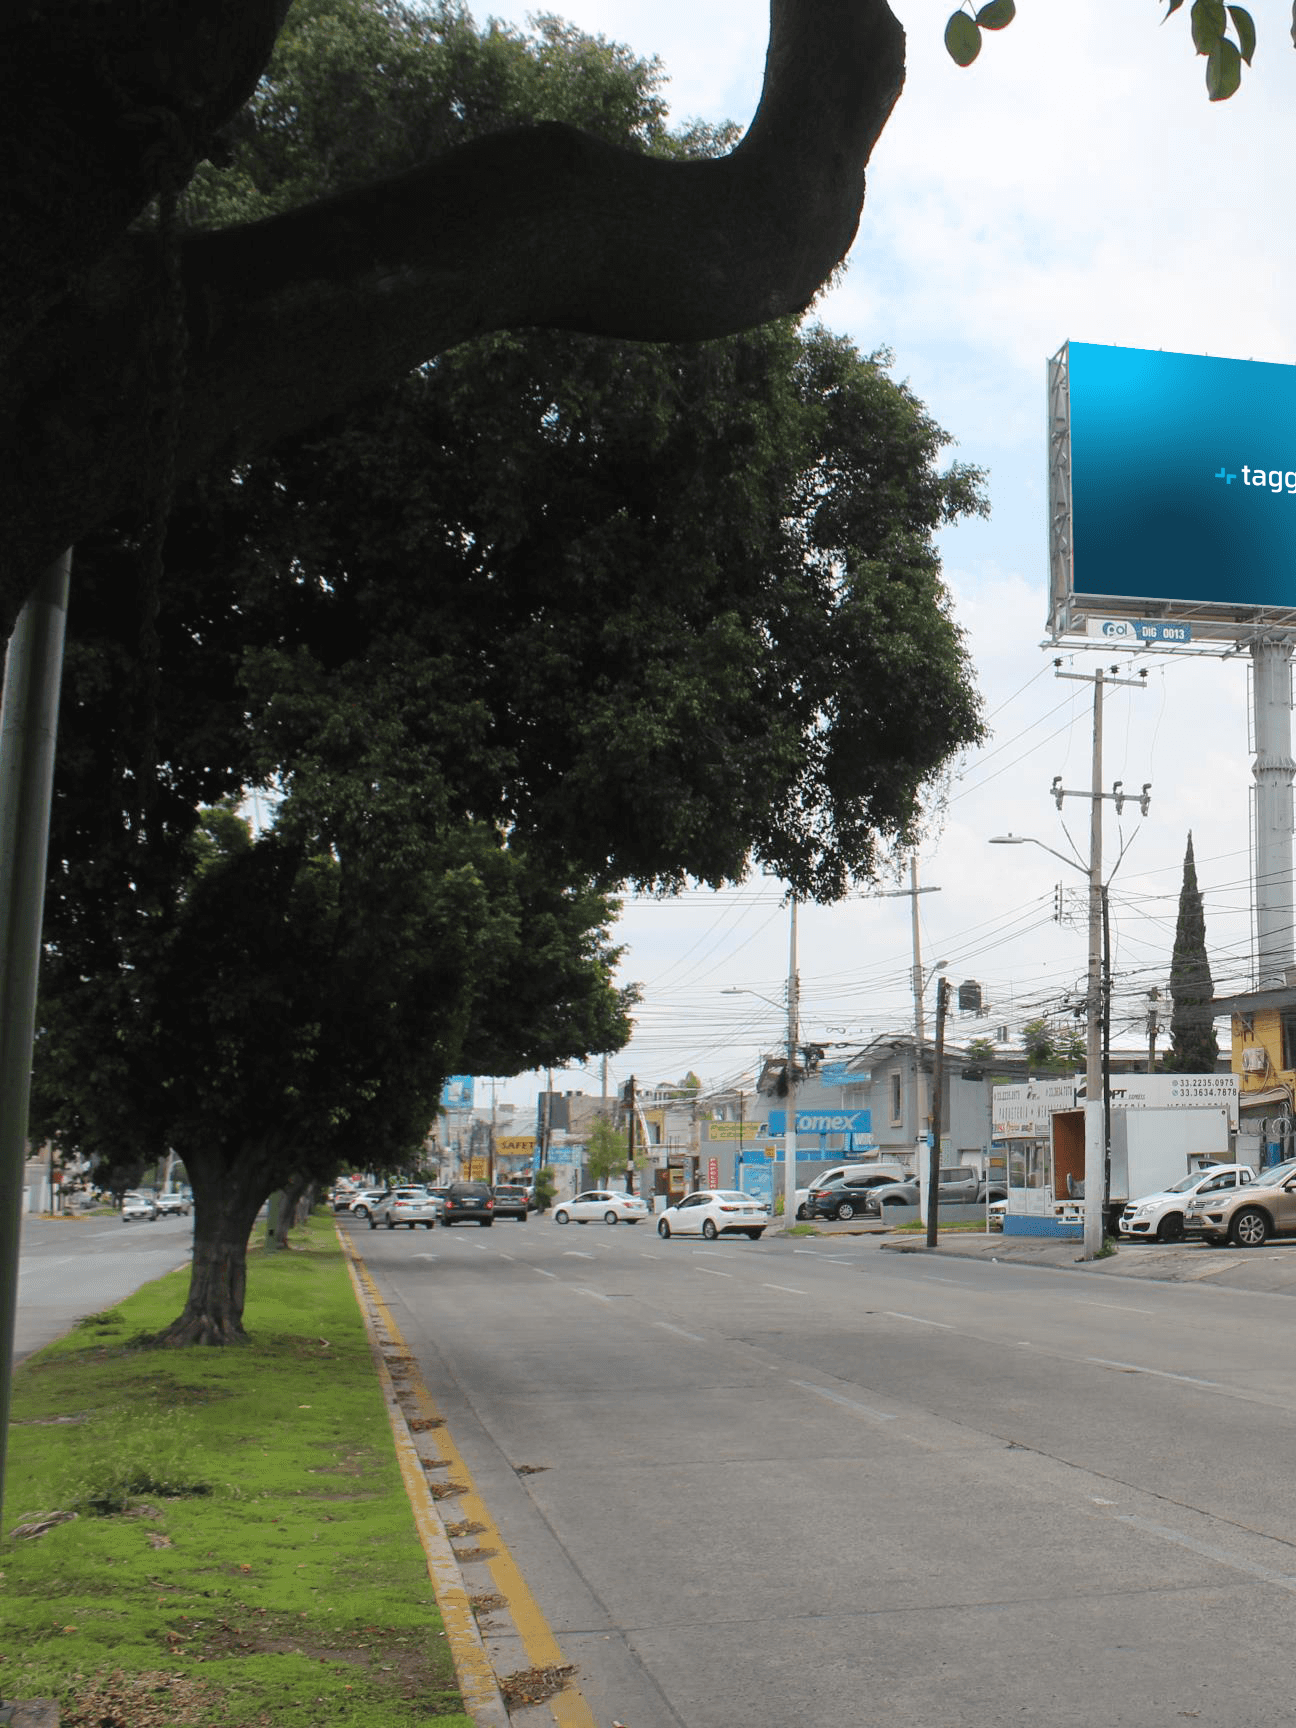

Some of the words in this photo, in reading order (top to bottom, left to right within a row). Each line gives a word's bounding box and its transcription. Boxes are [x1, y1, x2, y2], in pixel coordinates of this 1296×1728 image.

[1142, 626, 1156, 637] DIG
[1163, 628, 1184, 639] 0013
[1180, 1079, 1234, 1087] 33.2235.0975
[1180, 1088, 1237, 1097] 33.3634.7878
[796, 1112, 862, 1131] omex
